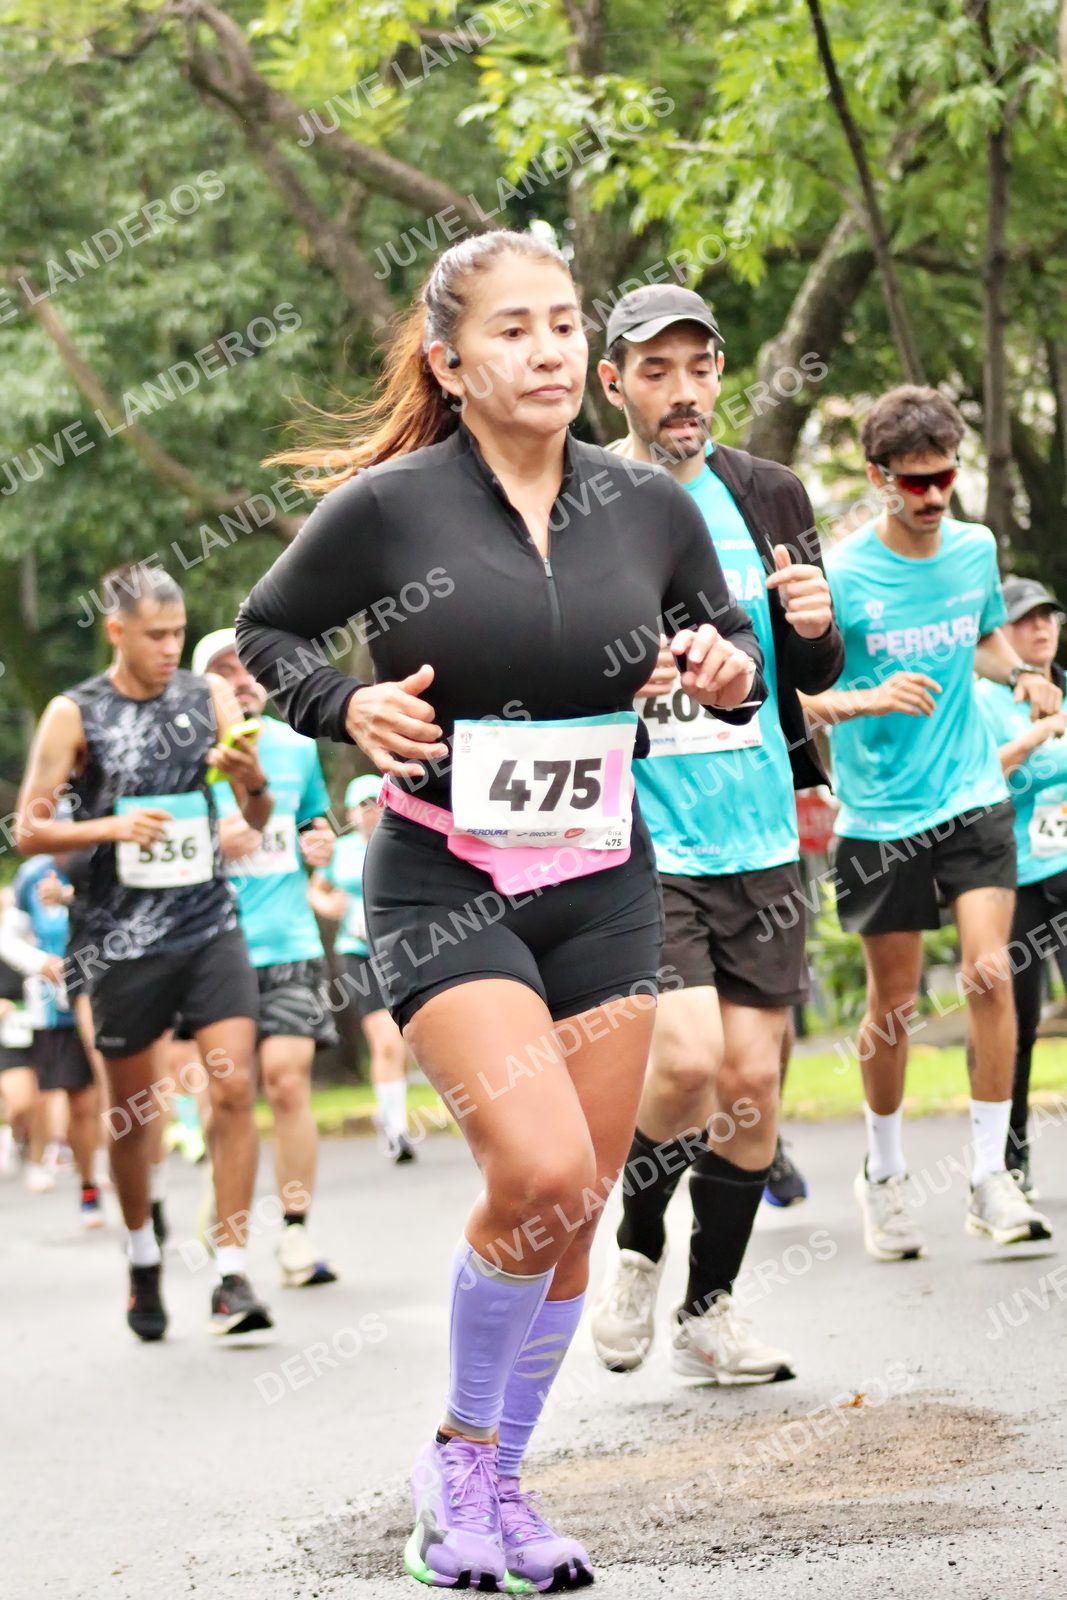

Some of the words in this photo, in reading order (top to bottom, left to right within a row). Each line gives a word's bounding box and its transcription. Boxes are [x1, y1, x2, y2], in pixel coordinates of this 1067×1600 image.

[643, 687, 720, 724] 40
[489, 758, 602, 812] 475
[401, 796, 449, 831] NIKE
[466, 828, 509, 837] PERDURA
[605, 838, 622, 847] 475
